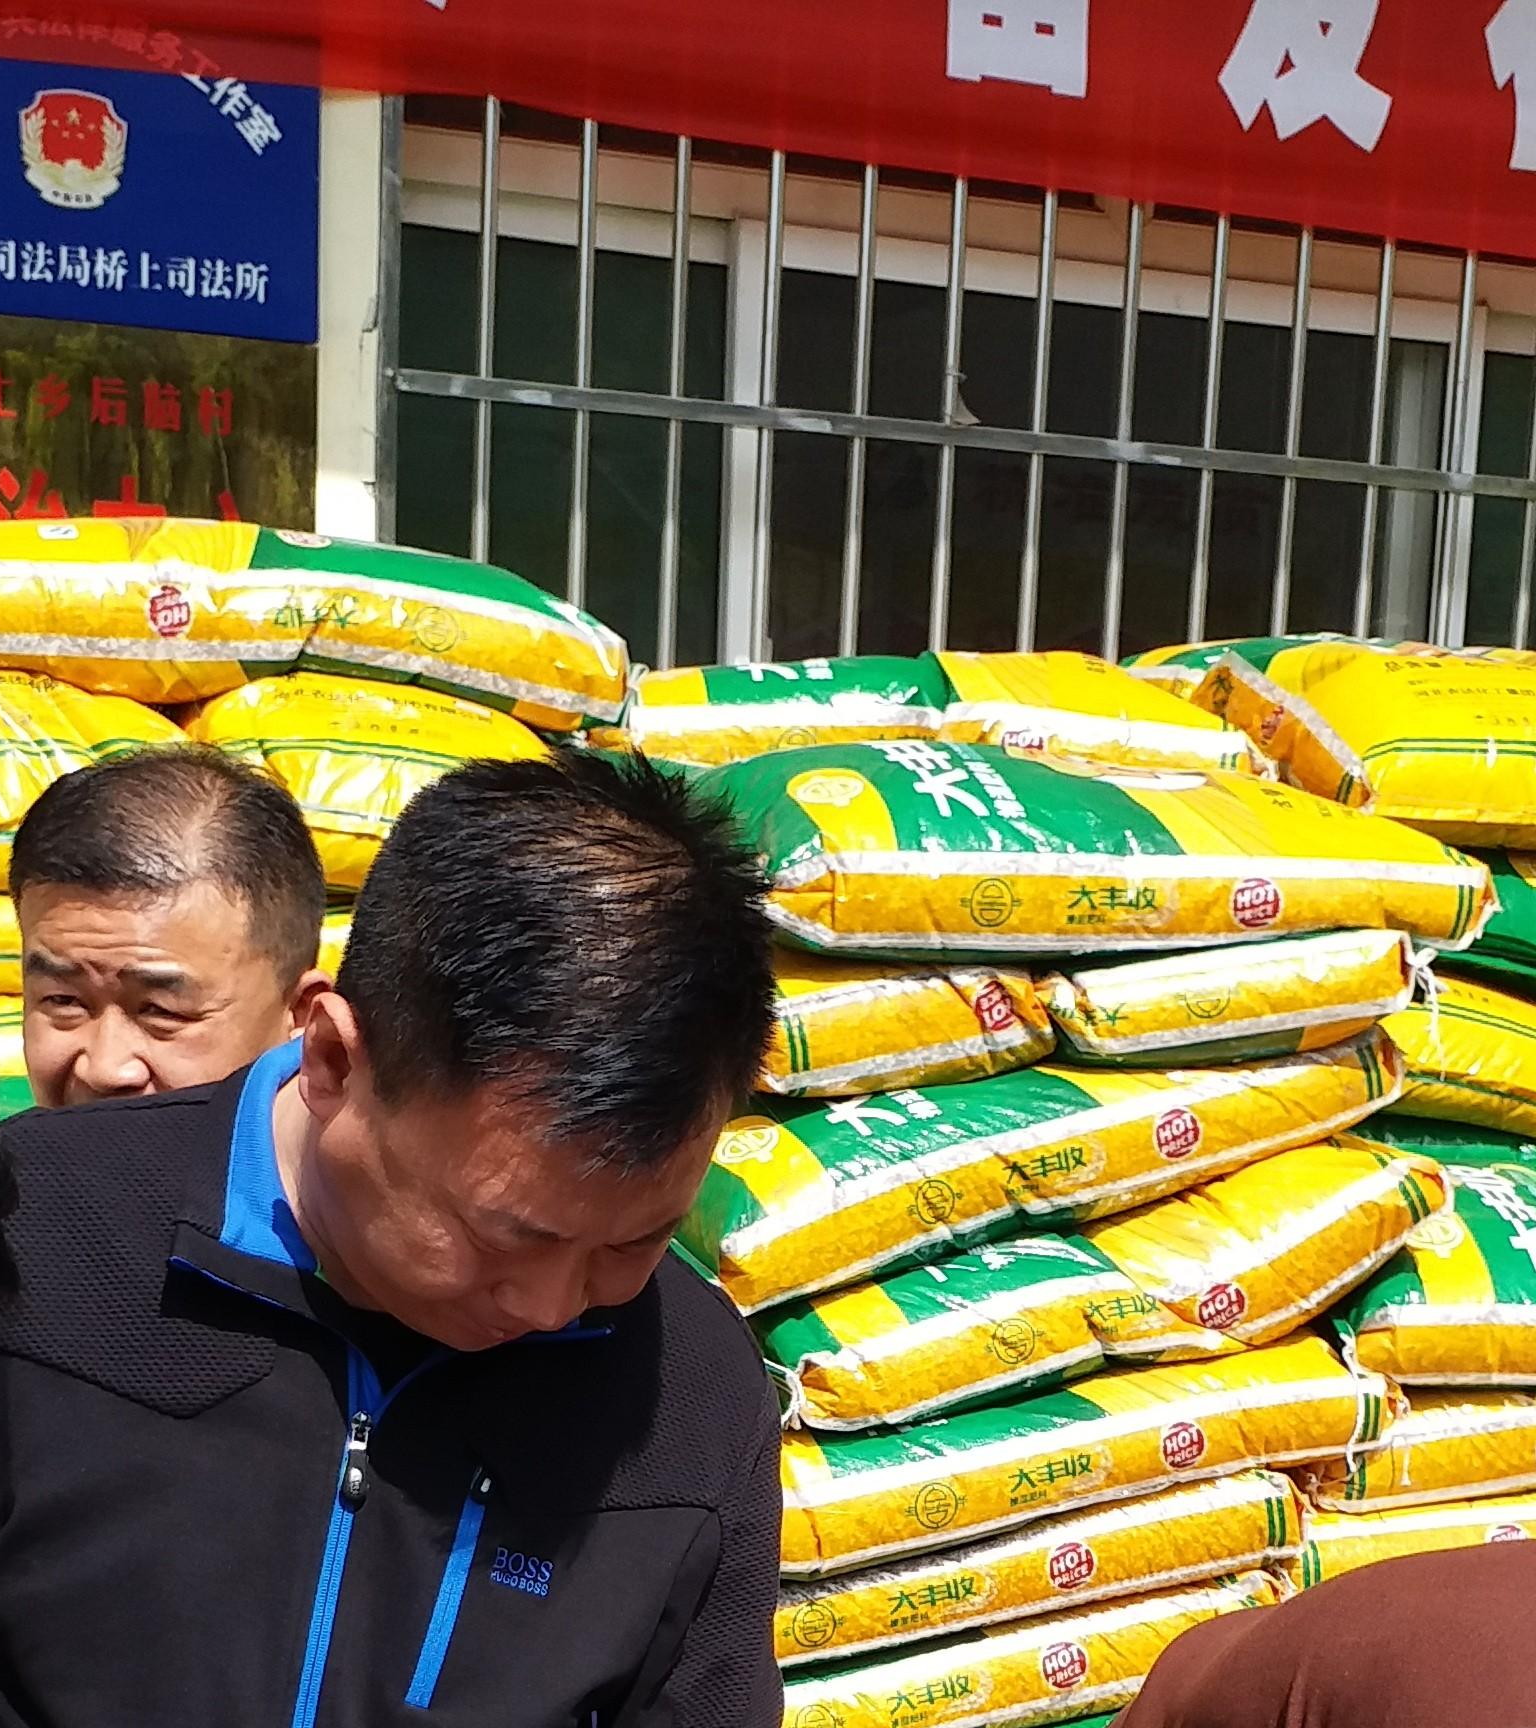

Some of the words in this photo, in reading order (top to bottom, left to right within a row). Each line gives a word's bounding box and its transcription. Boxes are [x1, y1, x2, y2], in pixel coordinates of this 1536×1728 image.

[1067, 885, 1159, 911] 大丰收
[1233, 888, 1278, 912] HOT
[1157, 1113, 1195, 1145] HOT
[1002, 1146, 1088, 1185] 大丰收
[1085, 1293, 1161, 1323] 大丰收
[1201, 1285, 1240, 1320] HOT
[1164, 1426, 1200, 1454] HOT
[1166, 1443, 1202, 1470] PRICE
[1007, 1452, 1093, 1493] 大丰收
[494, 1546, 554, 1583] BOSS
[1050, 1545, 1089, 1575] HOT
[1054, 1562, 1093, 1588] PRICE
[888, 1576, 977, 1615] 大丰收
[1043, 1646, 1080, 1674] HOT
[1047, 1664, 1083, 1688] PRICE
[886, 1673, 975, 1716] 大丰收
